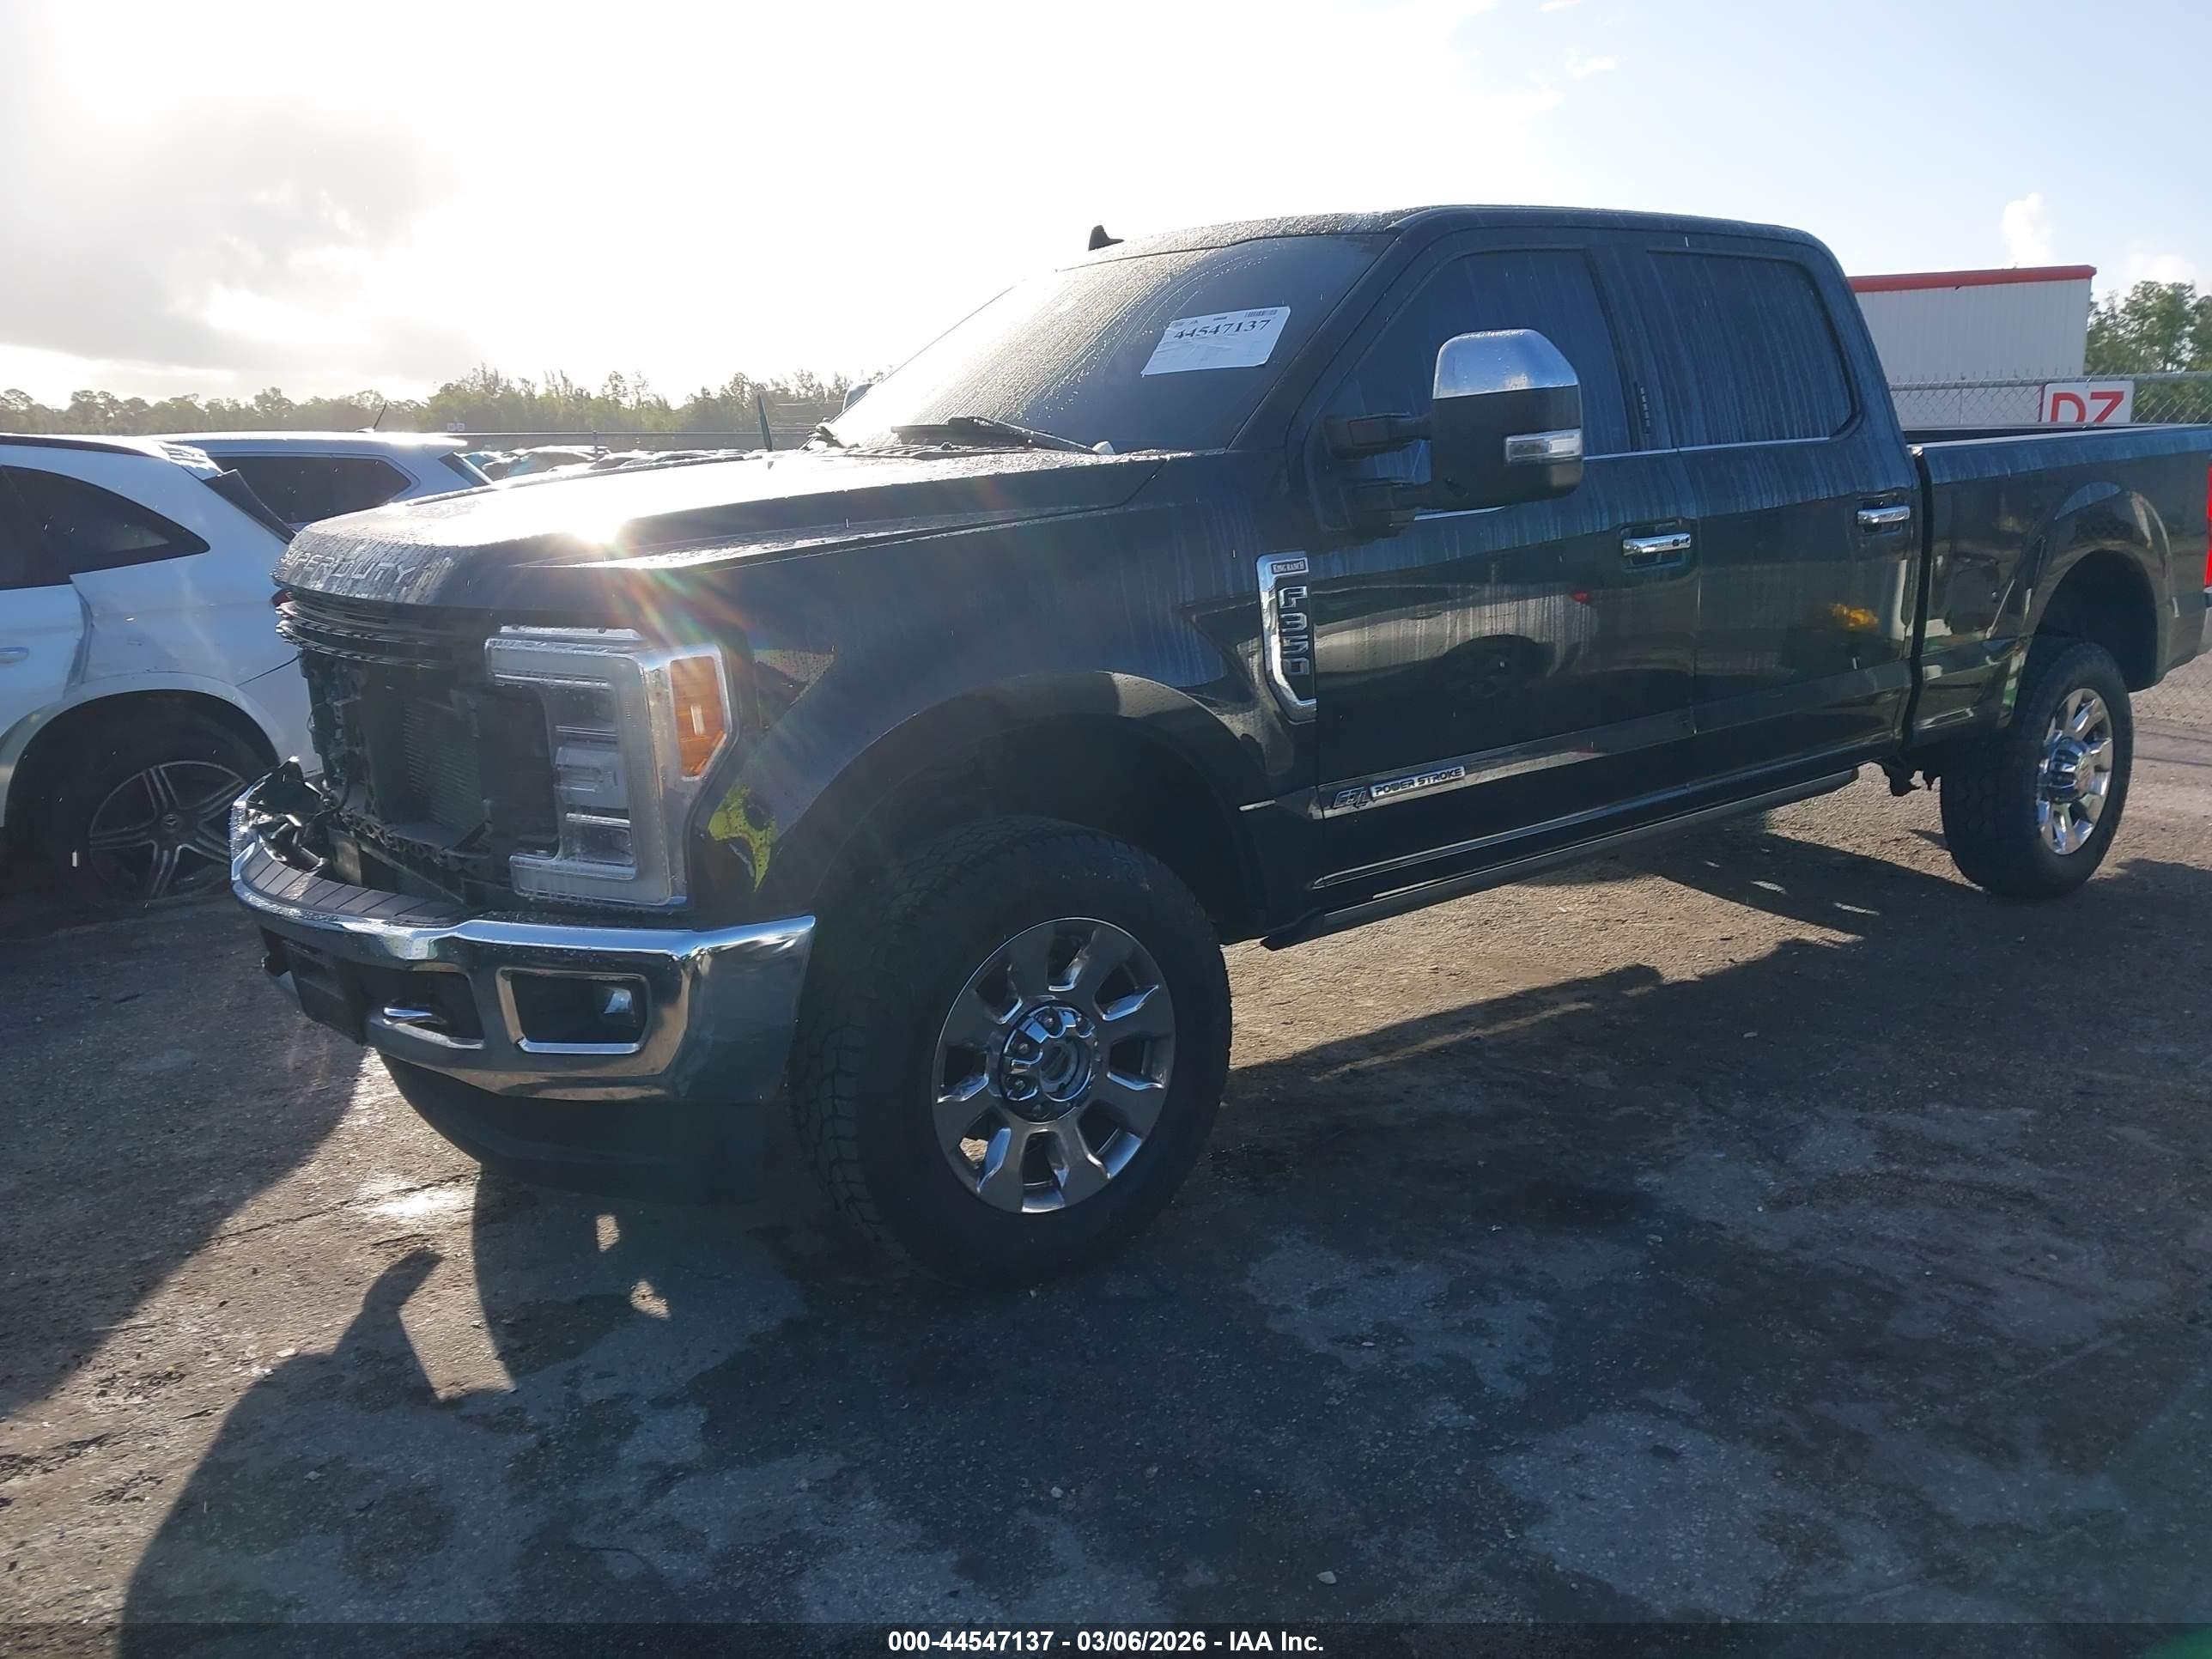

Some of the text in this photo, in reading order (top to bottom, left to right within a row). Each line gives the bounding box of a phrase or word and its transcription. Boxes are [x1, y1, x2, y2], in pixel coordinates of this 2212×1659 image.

[1174, 319, 1271, 338] 44547137
[1279, 586, 1310, 676] F350
[1375, 779, 1416, 795] POWER
[1418, 769, 1462, 784] STROKE
